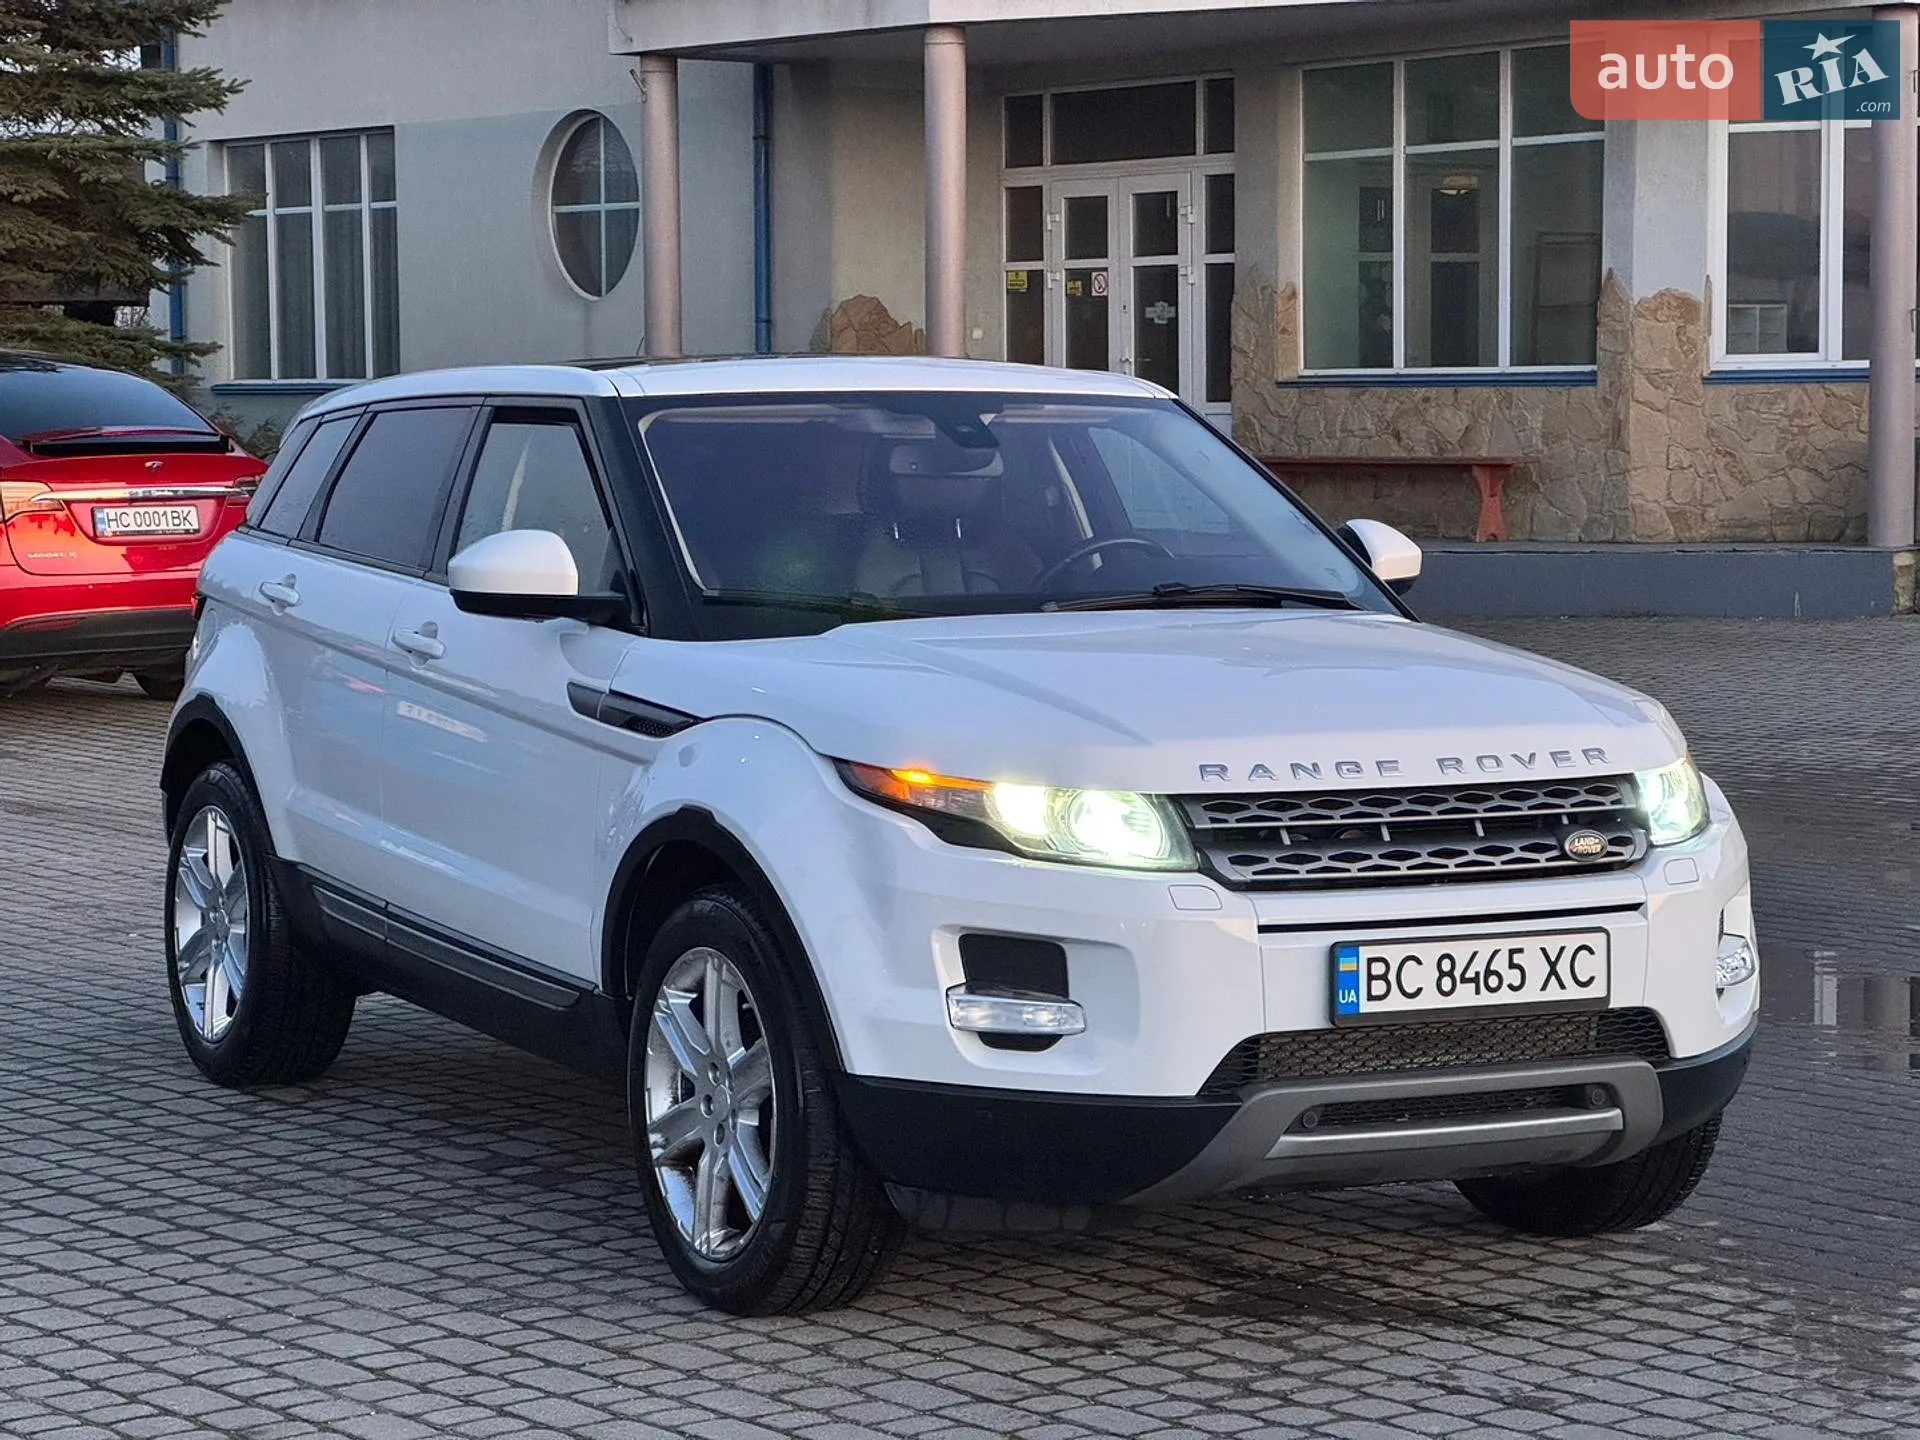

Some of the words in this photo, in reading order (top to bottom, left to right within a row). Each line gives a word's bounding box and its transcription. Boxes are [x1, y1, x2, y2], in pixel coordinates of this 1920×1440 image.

[106, 511, 131, 529] HC
[133, 510, 170, 528] 0001
[171, 509, 193, 527] BK
[1199, 760, 1405, 783] RANGE
[1436, 747, 1612, 775] ROVER
[1366, 955, 1424, 1003] BC
[1435, 947, 1527, 998] 8465
[1539, 944, 1597, 992] XC
[1338, 988, 1358, 1005] UA
